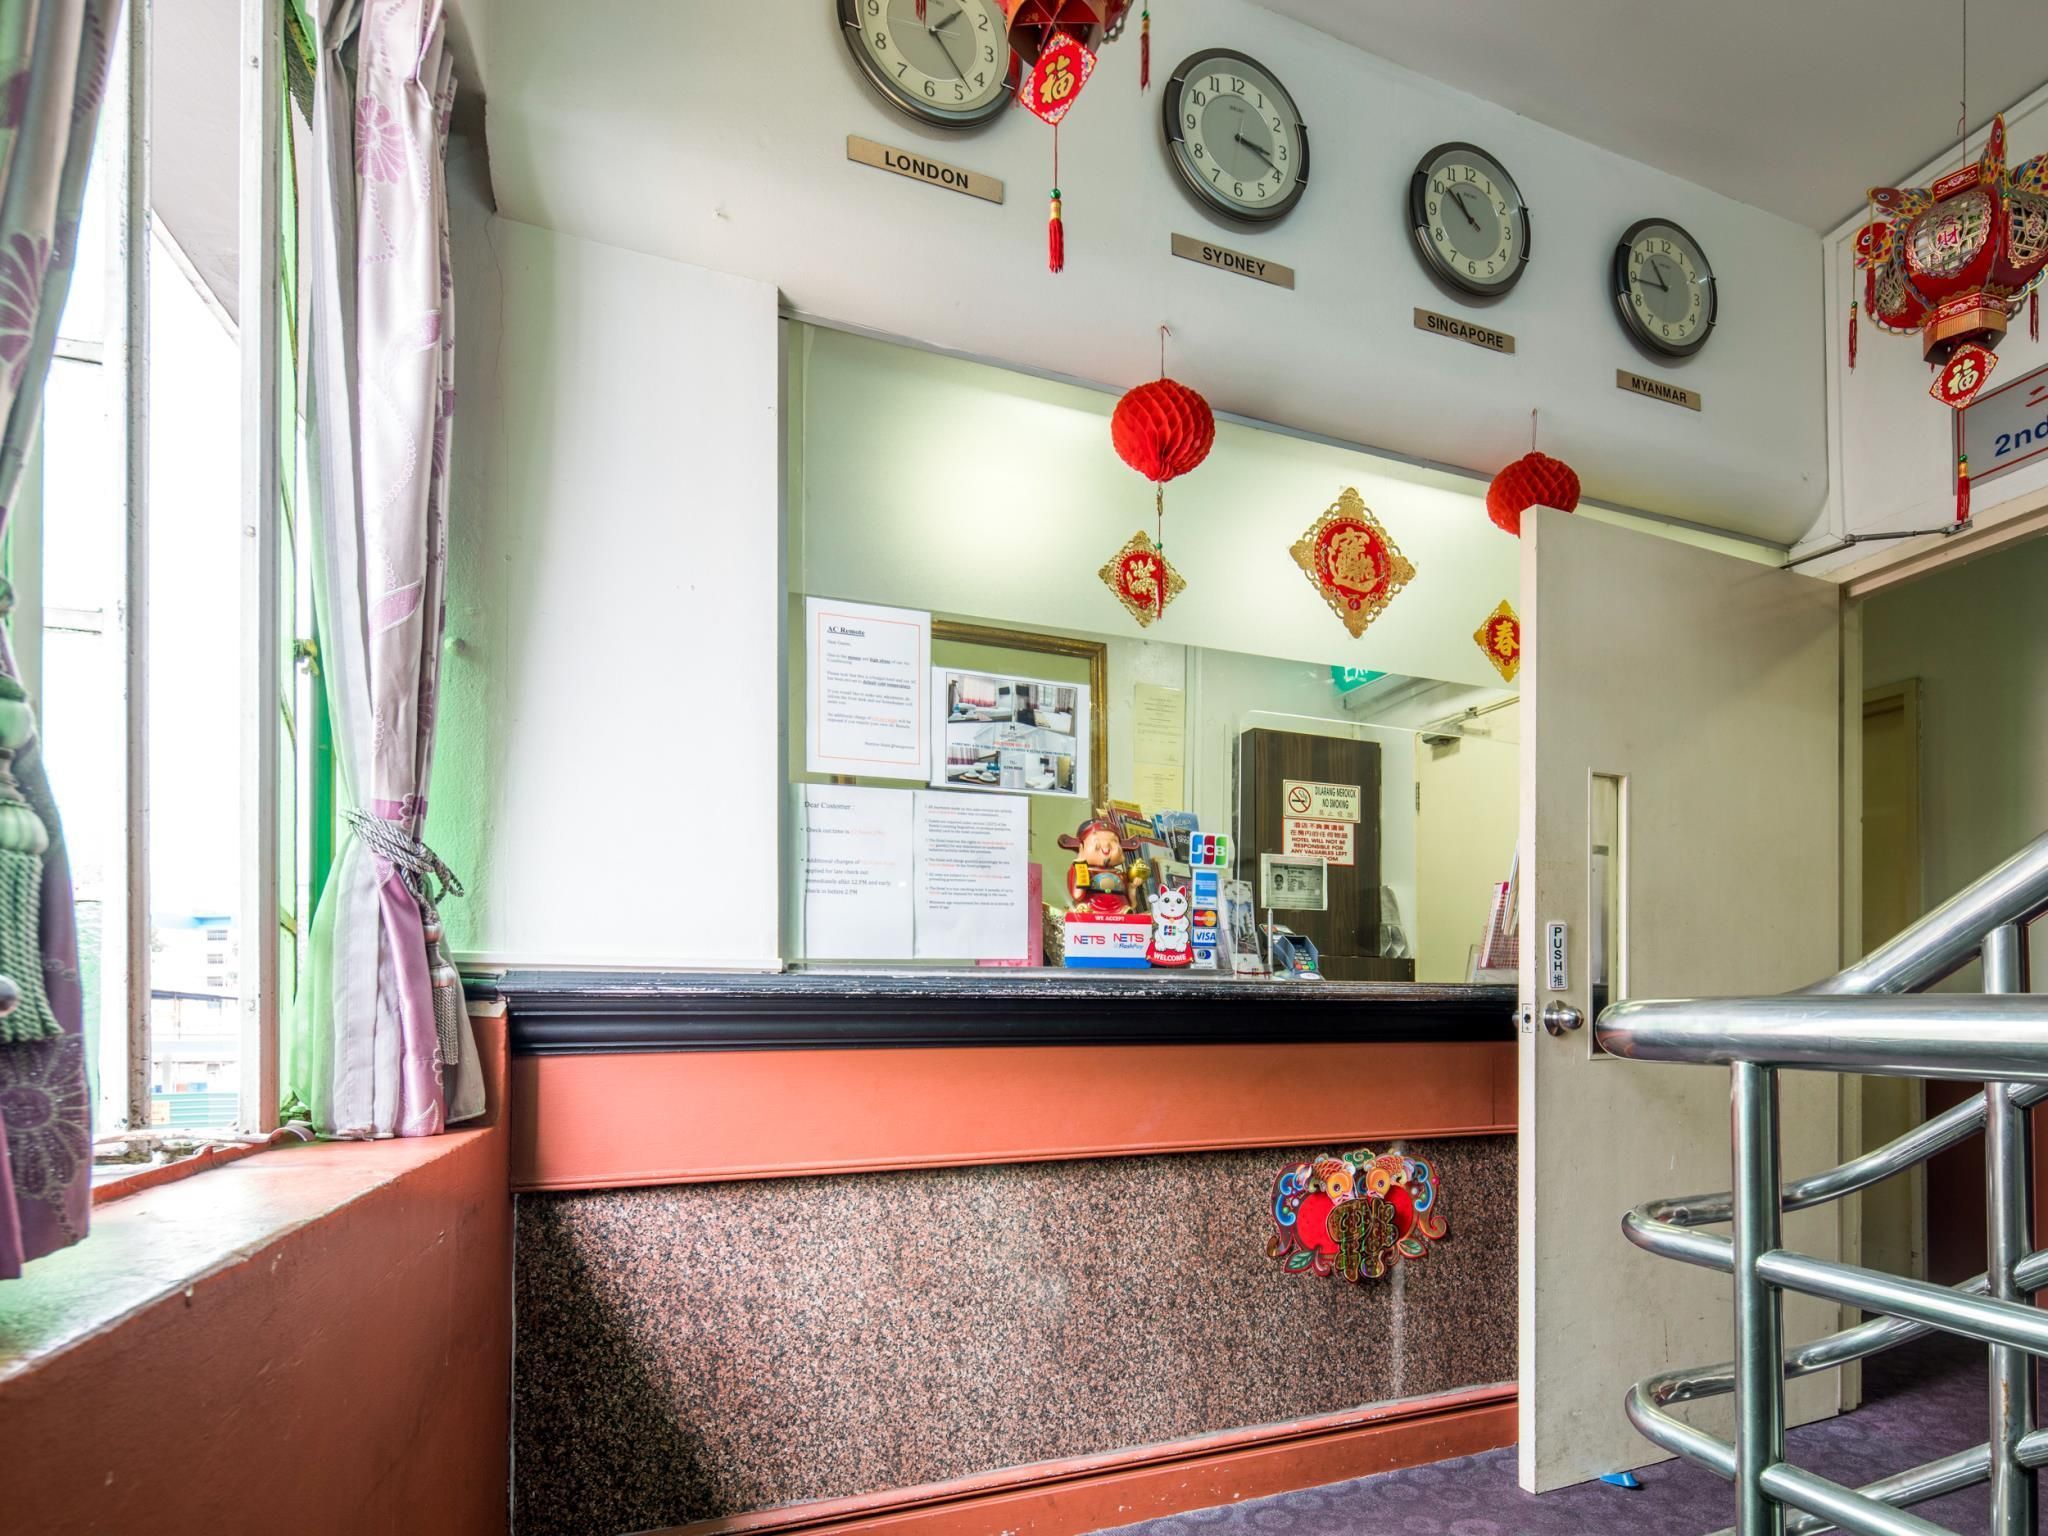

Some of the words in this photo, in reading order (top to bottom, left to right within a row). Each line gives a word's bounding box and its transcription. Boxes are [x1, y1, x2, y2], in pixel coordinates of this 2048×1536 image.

[867, 0, 879, 16] 9
[978, 14, 988, 32] 2
[875, 32, 887, 49] 8
[984, 45, 994, 63] 3
[897, 62, 908, 78] 7
[974, 72, 985, 87] 4
[1040, 55, 1075, 104] 福
[1209, 75, 1220, 93] 11
[1230, 77, 1245, 95] 12
[924, 80, 935, 97] 6
[954, 84, 964, 101] 5
[1192, 88, 1206, 107] 10
[1257, 93, 1264, 109] 1
[1186, 114, 1196, 129] 9
[1273, 117, 1281, 133] 2
[1194, 143, 1203, 159] 8
[1279, 145, 1287, 161] 3
[885, 150, 968, 189] LONDON
[1211, 168, 1221, 183] 7
[1272, 169, 1281, 184] 4
[1447, 167, 1456, 182] 11
[1464, 167, 1476, 183] 12
[1234, 182, 1243, 197] 6
[1257, 183, 1265, 198] 5
[1433, 180, 1445, 195] 10
[1486, 181, 1491, 195] 1
[1429, 201, 1437, 216] 9
[1499, 202, 1506, 216] 2
[1435, 228, 1443, 241] 8
[1504, 226, 1511, 241] 3
[1647, 240, 1654, 253] 11
[1662, 240, 1671, 255] 12
[1203, 246, 1265, 276] SYDNEY
[1450, 249, 1457, 262] 7
[1499, 248, 1506, 262] 4
[1635, 250, 1644, 265] 10
[1680, 252, 1684, 265] 1
[1468, 261, 1476, 275] 6
[1487, 261, 1494, 275] 5
[1630, 270, 1637, 283] 9
[1690, 272, 1696, 284] 2
[1635, 294, 1642, 307] 8
[1694, 293, 1700, 306] 3
[1648, 313, 1654, 326] 7
[1689, 313, 1695, 325] 4
[1427, 316, 1504, 349] SINGAPORE
[1662, 324, 1669, 336] 6
[1679, 325, 1685, 336] 5
[1948, 359, 1979, 395] 福
[1632, 377, 1687, 403] MYANMAR
[827, 626, 838, 635] AC
[840, 626, 865, 637] Remote
[1494, 621, 1519, 657] 春
[1315, 786, 1336, 797] DILARANG
[1336, 789, 1356, 799] MEROKOK
[1322, 799, 1329, 808] NO
[1330, 799, 1349, 809] SMOKING
[1191, 844, 1226, 856] JCB
[1073, 935, 1106, 945] NETS
[1113, 933, 1144, 943] NETS
[1196, 932, 1216, 941] VISA
[1553, 926, 1563, 971] PUSH
[1153, 951, 1187, 962] WELCOME
[1553, 973, 1564, 987] 推
